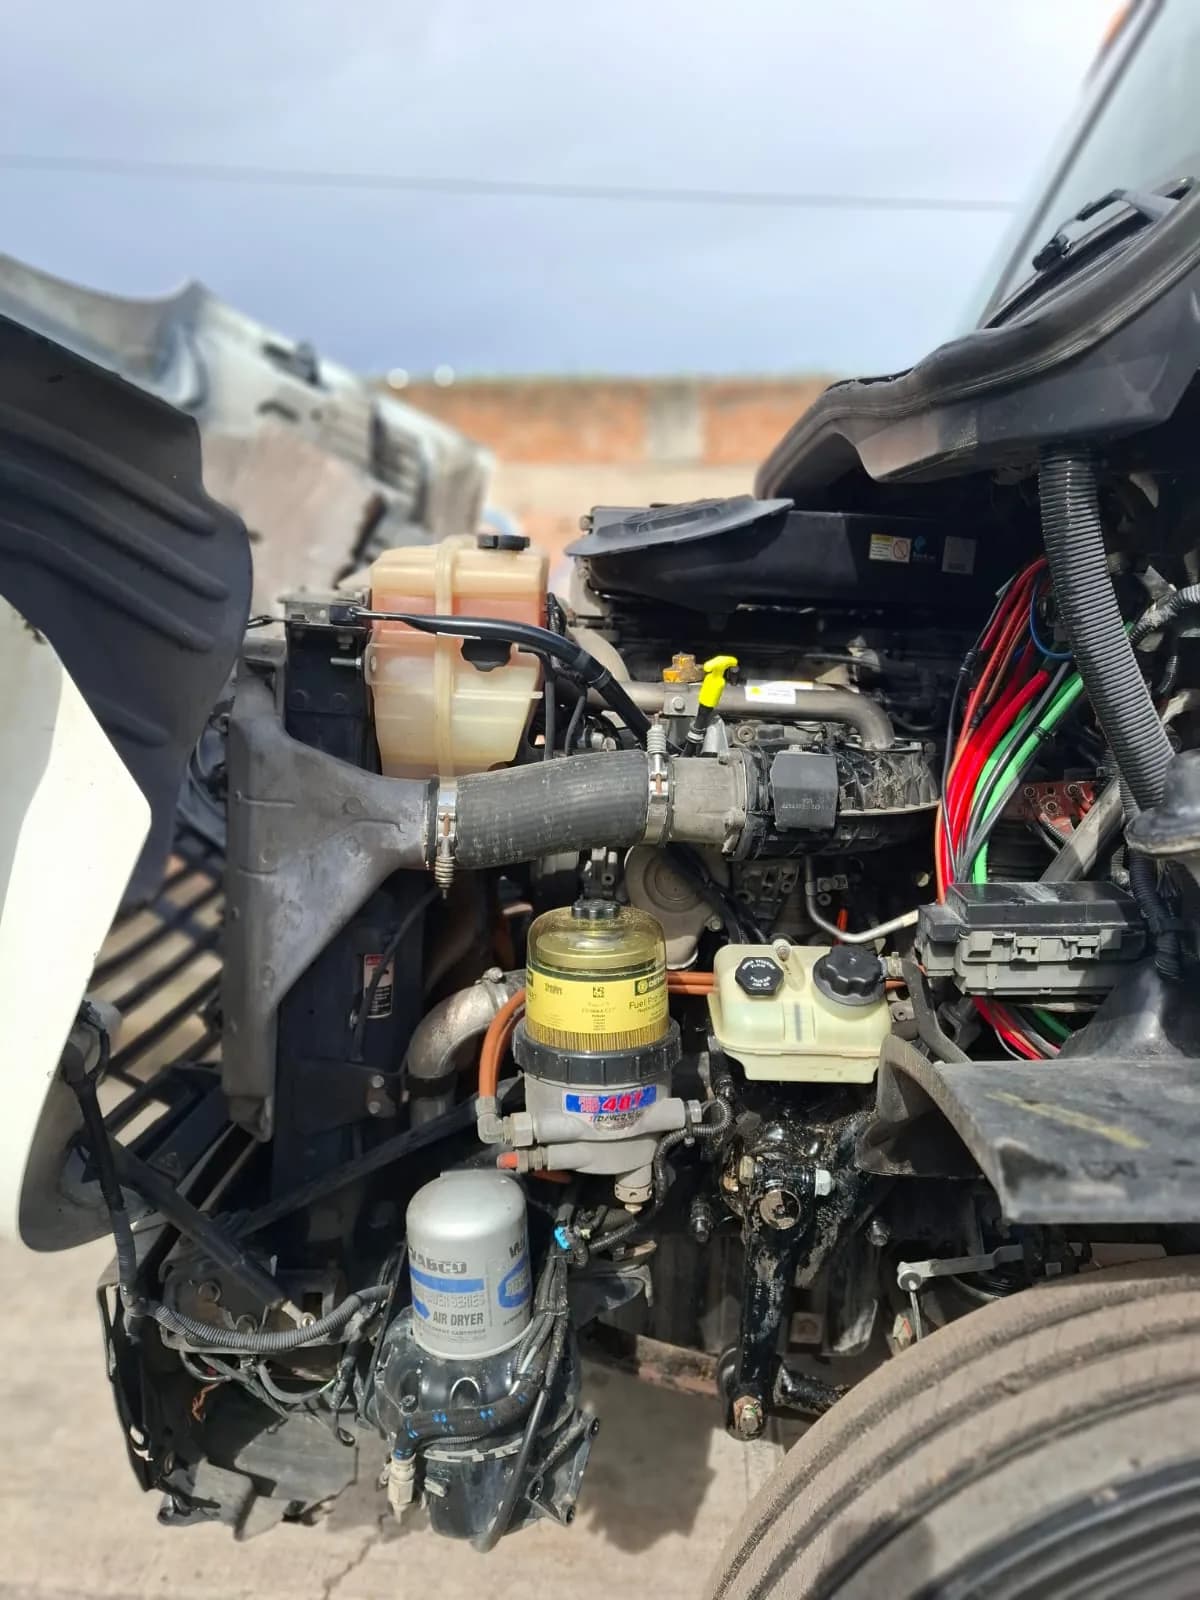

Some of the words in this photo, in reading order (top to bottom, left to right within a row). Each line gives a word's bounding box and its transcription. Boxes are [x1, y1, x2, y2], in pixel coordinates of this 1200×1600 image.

[629, 999, 646, 1009] Fuel
[433, 1311, 448, 1325] AIR
[450, 1312, 484, 1326] DRYER
